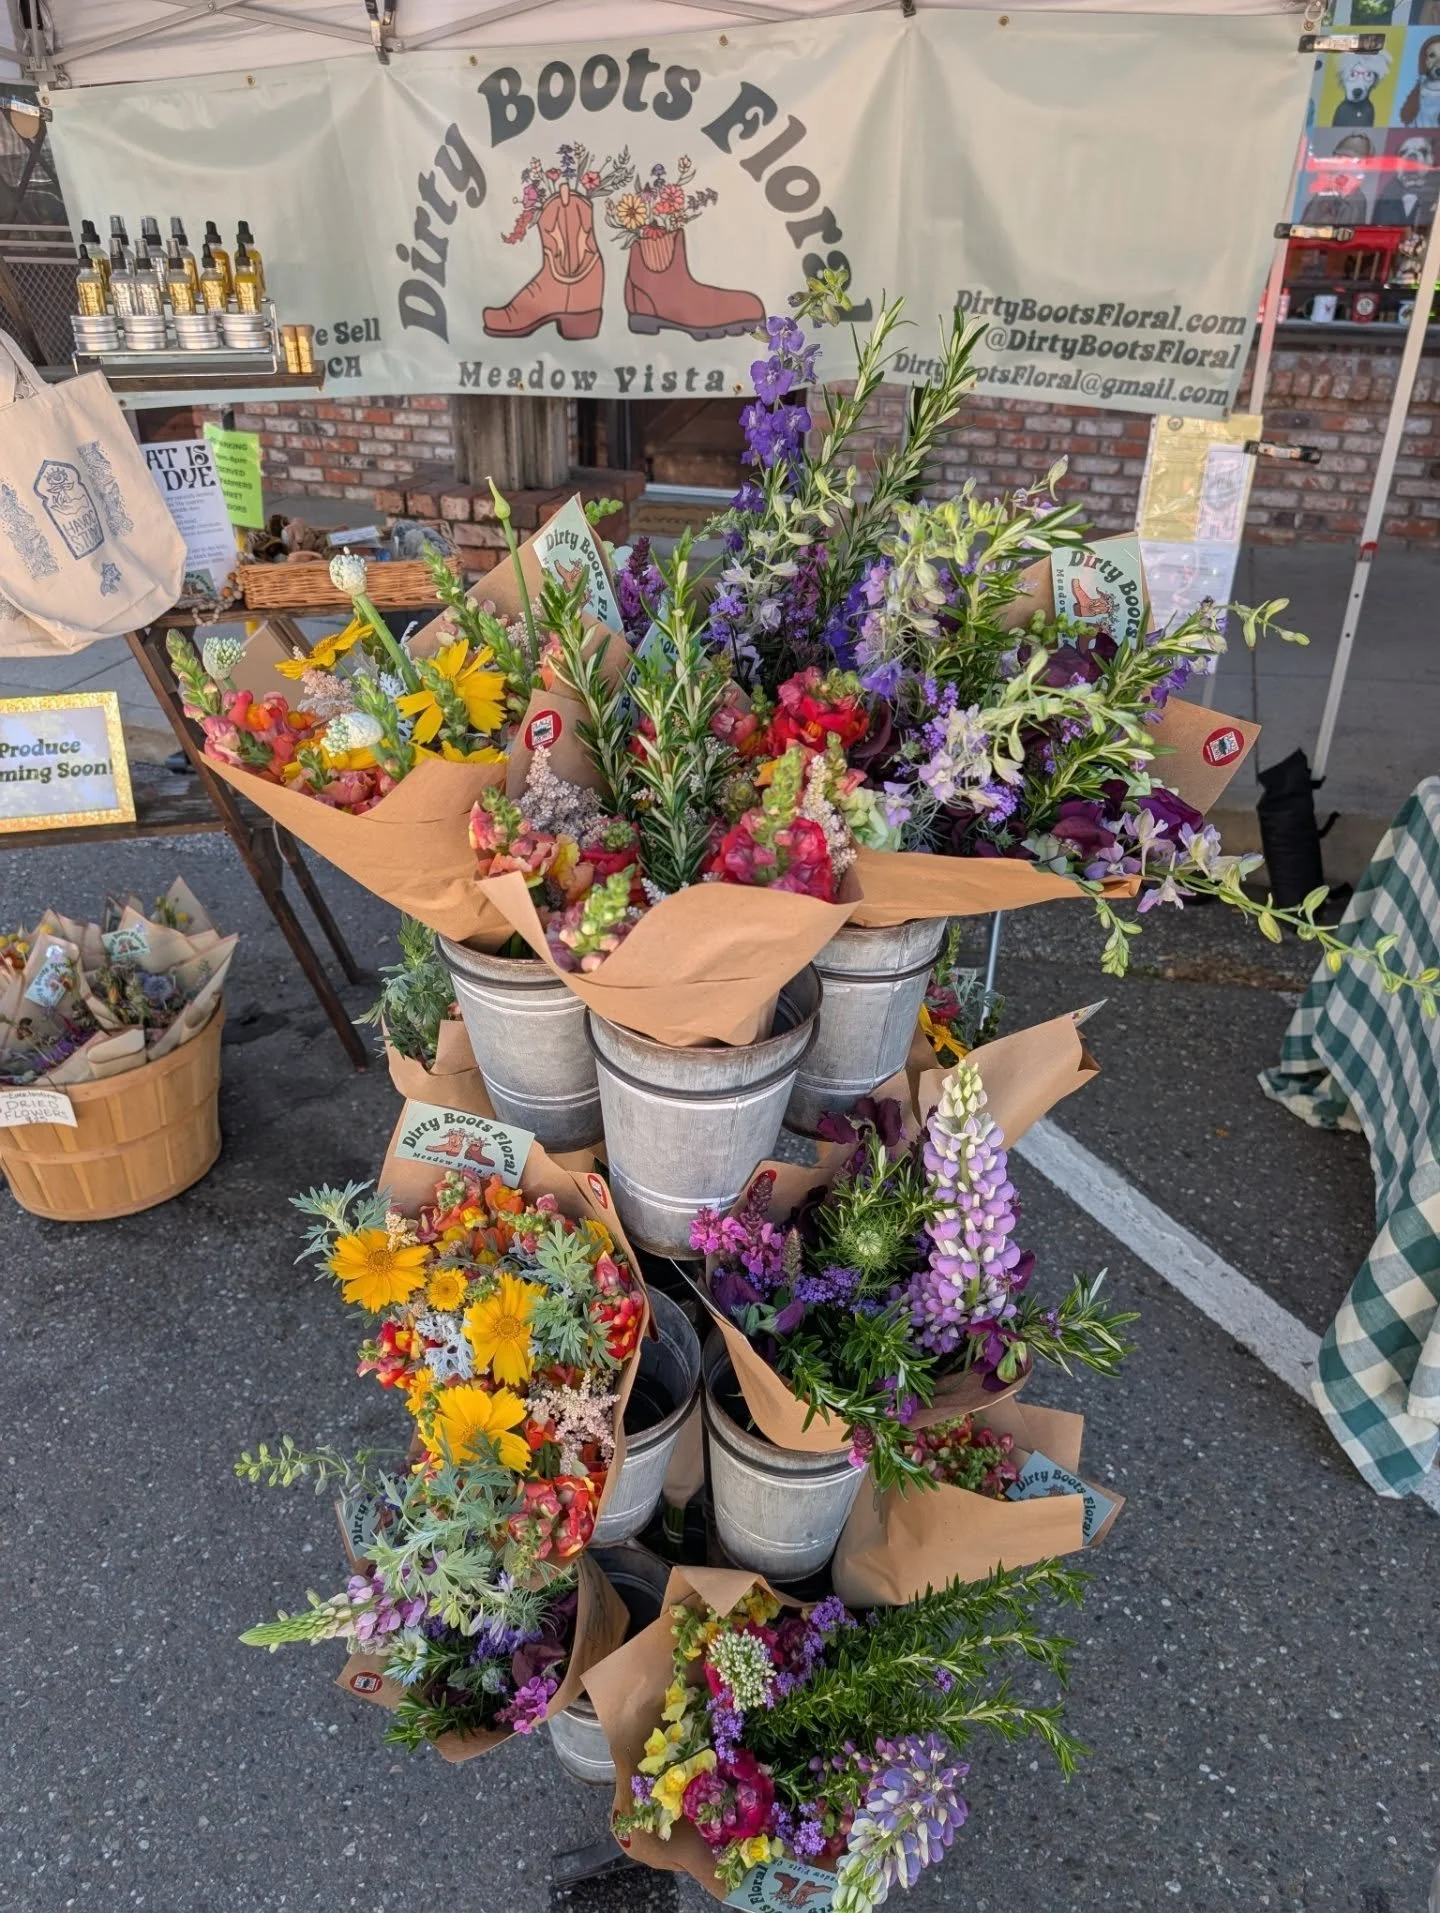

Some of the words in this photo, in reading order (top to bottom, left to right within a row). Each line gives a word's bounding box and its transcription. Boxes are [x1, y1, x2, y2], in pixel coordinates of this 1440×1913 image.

[397, 122, 487, 344] Dirty
[477, 47, 701, 148] Boots
[700, 81, 873, 323] Floral
[955, 289, 1247, 335] DirtyBootsFloral.com
[333, 317, 382, 345] Sell
[984, 327, 1242, 369] @DirtyBootsFloral
[457, 360, 599, 392] Meadow
[614, 364, 726, 394] Vista
[892, 352, 1230, 406] DirtyotsFloral@gmail.com
[146, 447, 177, 471] AT
[185, 445, 209, 467] IS
[163, 466, 216, 491] DYE
[545, 529, 579, 551] Dirty
[579, 537, 605, 591] Boots
[1068, 550, 1124, 583] Dirty
[1118, 580, 1141, 639] Boots
[0, 738, 81, 758] Produce
[0, 765, 52, 784] ming
[4, 1108, 68, 1120] FLOWERS
[402, 1117, 441, 1149] Dirty
[443, 1112, 494, 1133] Boots
[491, 1130, 518, 1177] Floral
[412, 1152, 453, 1165] Meadow
[1015, 1470, 1049, 1493] Dirty
[1051, 1469, 1087, 1494] Boots
[747, 1863, 769, 1905] Floral
